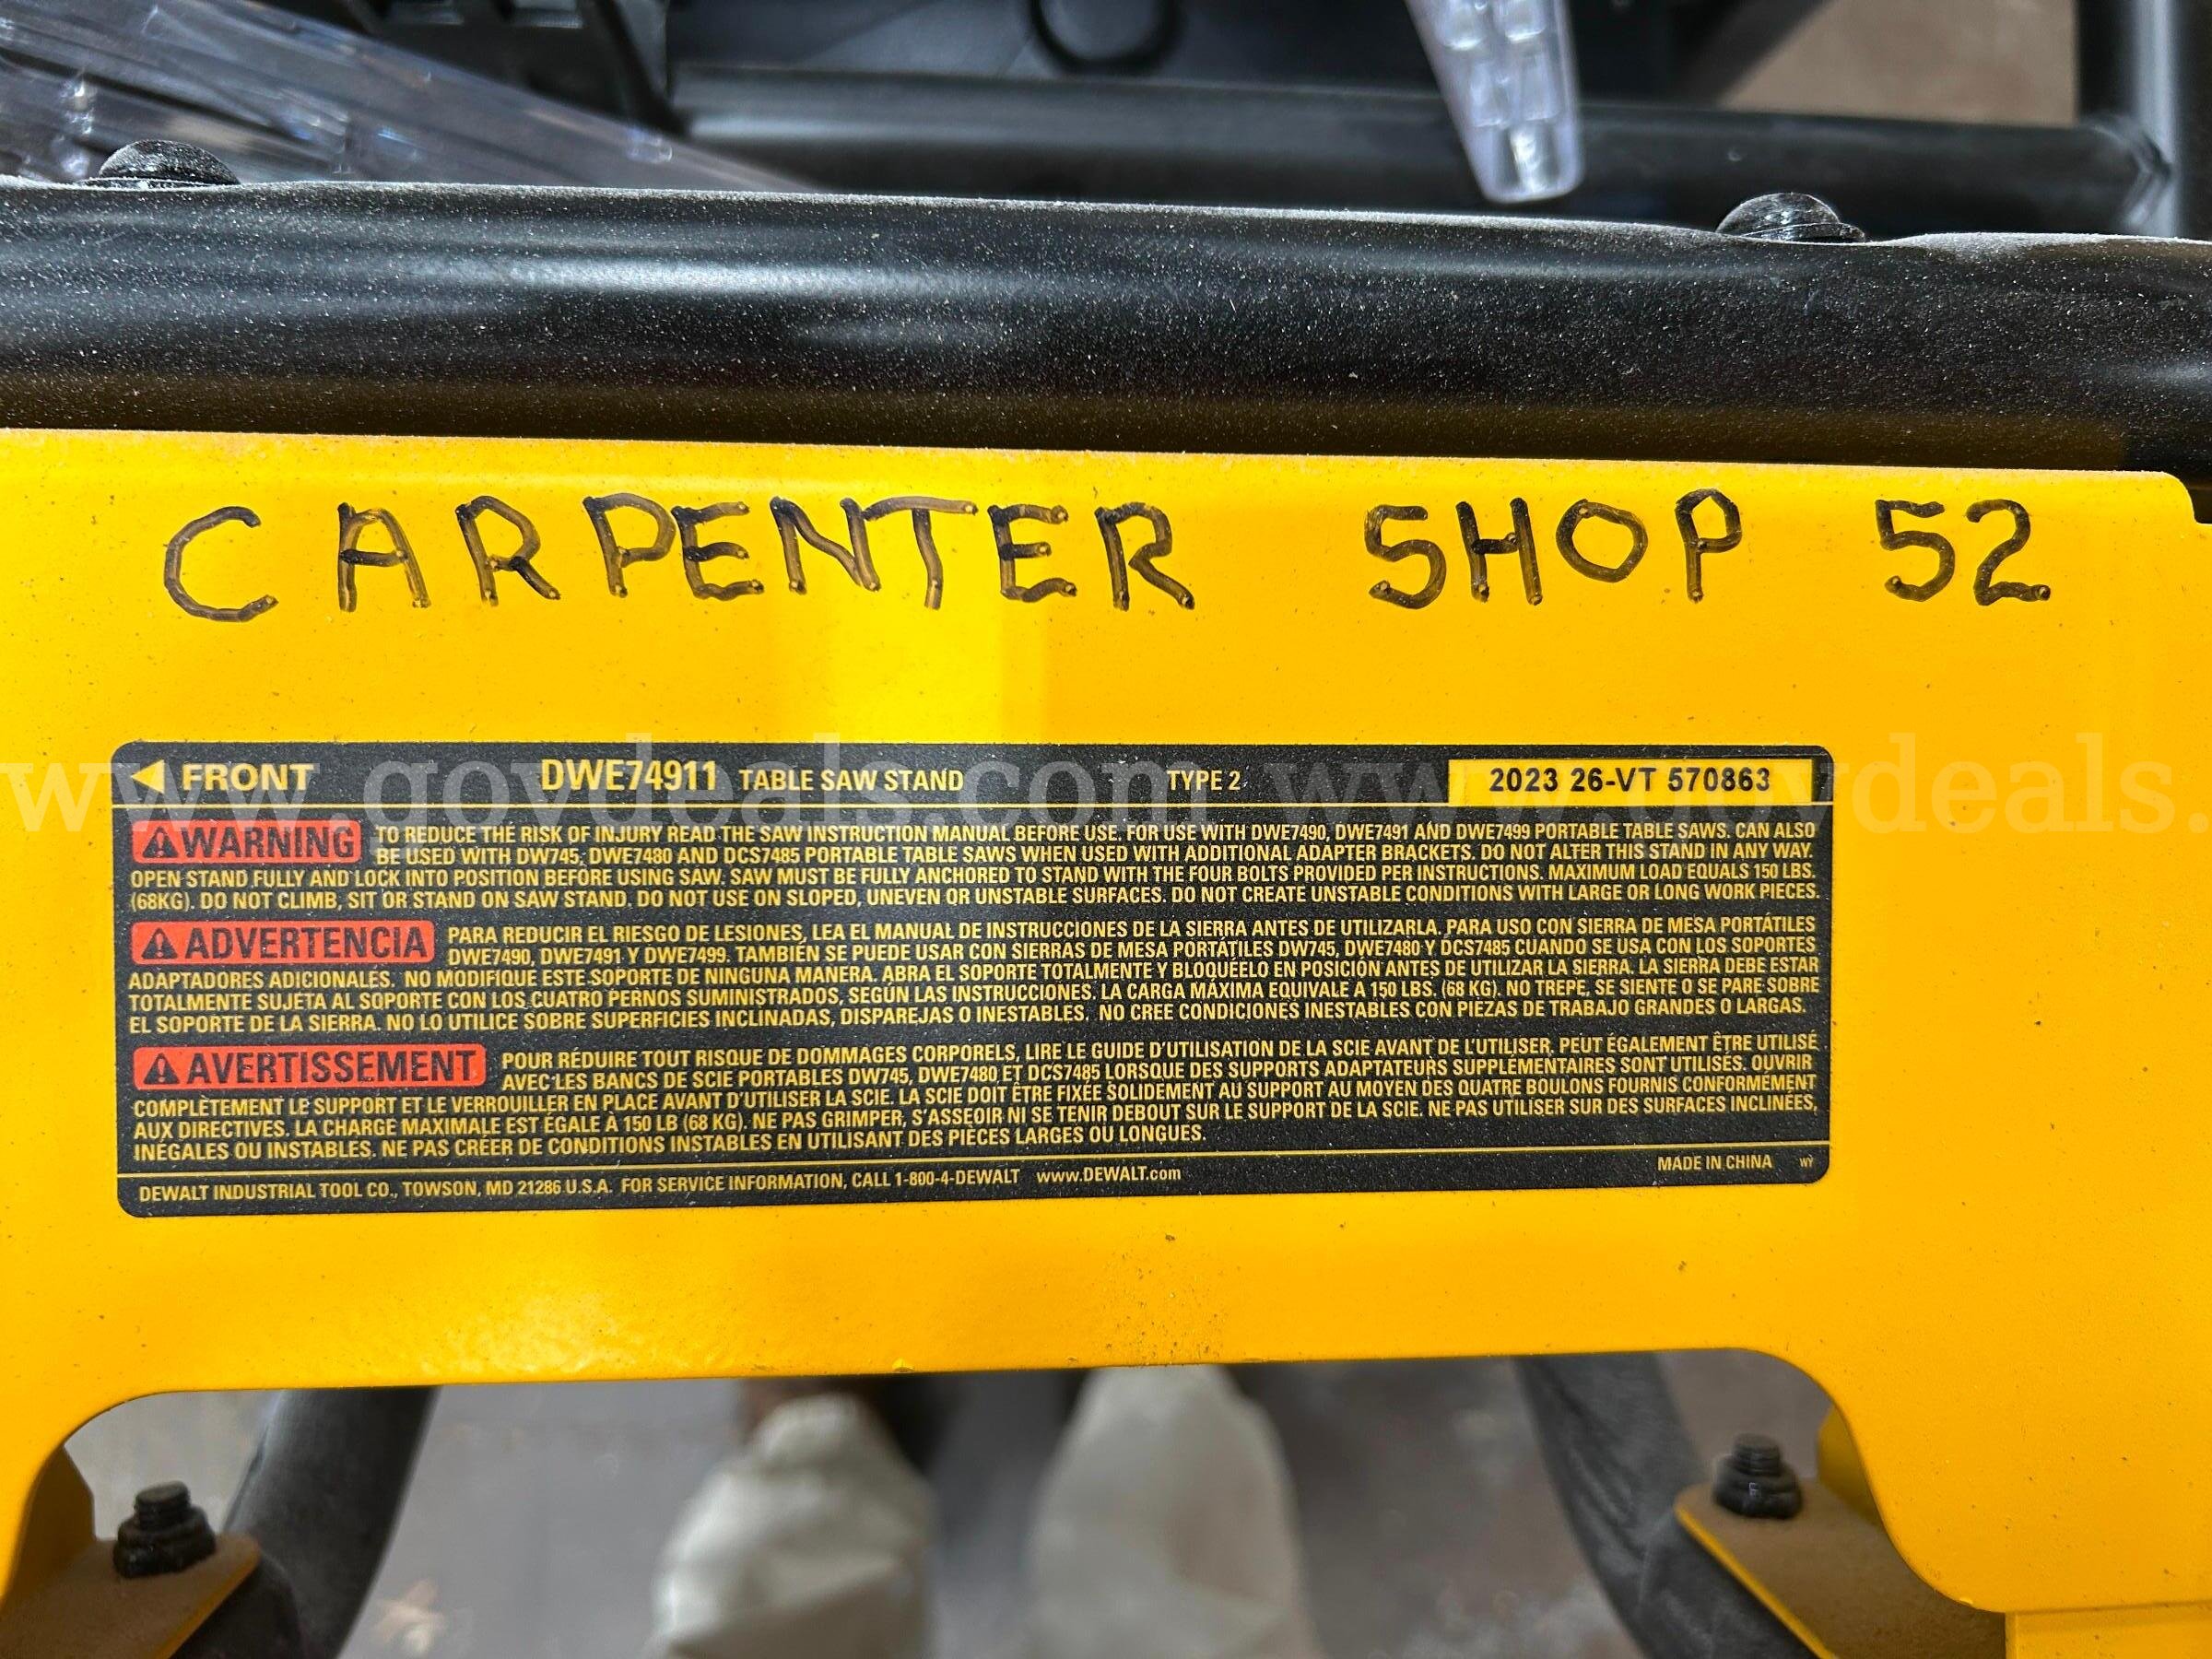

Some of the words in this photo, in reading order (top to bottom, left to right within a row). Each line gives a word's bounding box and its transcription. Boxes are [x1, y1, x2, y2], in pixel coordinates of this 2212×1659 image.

[163, 490, 1197, 623] CARPENTER
[1364, 488, 1743, 610] SHOP
[1875, 498, 2052, 606] 52
[182, 762, 315, 791] FRONT
[540, 759, 717, 791] DWE74911
[739, 769, 814, 791] TABLE
[821, 769, 877, 791] SAW
[884, 768, 964, 791] STAND
[1167, 770, 1222, 791] TYPE
[1229, 770, 1241, 791] 2
[1488, 767, 1559, 792] 2023
[1570, 767, 1657, 792] 26-VT
[1668, 767, 1771, 792] 570863
[181, 827, 355, 858] WARNING
[376, 825, 399, 843] TO
[405, 825, 476, 842] REDUCE
[481, 825, 514, 842] THE
[520, 825, 562, 842] RISK
[568, 825, 589, 842] OF
[594, 825, 662, 842] INJURY
[666, 825, 716, 842] READ
[722, 825, 755, 842] THE
[760, 824, 802, 842] SAW
[807, 824, 928, 841] INSTRUCTION
[933, 824, 1008, 841] MANUAL
[1014, 824, 1078, 841] BEFORE
[1084, 823, 1121, 841] USE.
[1125, 823, 1159, 841] FOR
[1164, 823, 1196, 841] USE
[1202, 823, 1246, 841] WITH
[1252, 823, 1330, 842] DWE7490,
[1335, 822, 1409, 841] DWE7491
[1415, 822, 1452, 840] AND
[1456, 822, 1533, 840] DWE7499
[1535, 822, 1618, 840] PORTABLE
[1624, 821, 1673, 839] TABLE
[1678, 821, 1731, 839] SAWS.
[1735, 821, 1771, 839] CAN
[1773, 821, 1818, 839] ALSO
[199, 891, 227, 910] DO
[232, 891, 271, 909] NOT
[276, 891, 342, 912] CLIMB,
[347, 890, 376, 909] SIT
[382, 890, 407, 908] OR
[413, 890, 477, 908] STAND
[482, 890, 510, 908] ON
[515, 889, 559, 908] SAW
[565, 889, 631, 907] STAND.
[636, 889, 665, 907] DO
[668, 888, 707, 907] NOT
[712, 888, 747, 906] USE
[753, 888, 782, 906] ON
[787, 888, 862, 908] SLOPED,
[866, 888, 941, 905] UNEVEN
[947, 888, 971, 905] OR
[976, 887, 1066, 905] UNSTABLE
[1072, 886, 1166, 904] SURFACES.
[1171, 886, 1196, 903] DO
[1201, 886, 1236, 903] NOT
[1241, 886, 1304, 903] CREATE
[1310, 885, 1400, 903] UNSTABLE
[1406, 884, 1514, 902] CONDITIONS
[1518, 884, 1565, 901] WITH
[1569, 884, 1621, 901] LARGE
[1627, 883, 1653, 901] OR
[1654, 883, 1701, 900] LONG
[1705, 883, 1756, 900] WORK
[1758, 882, 1819, 900] PIECES.
[185, 927, 428, 959] ADVERTENCIA
[448, 925, 498, 944] PARA
[502, 925, 582, 943] REDUCIR
[586, 924, 606, 943] EL
[612, 924, 680, 942] RIESGO
[686, 924, 709, 941] DE
[714, 923, 806, 944] LESIONES,
[811, 923, 845, 940] LEA
[850, 923, 869, 940] EL
[875, 922, 952, 940] MANUAL
[958, 922, 981, 939] DE
[986, 920, 1127, 938] INSTRUCCIONES
[1133, 920, 1153, 937] DE
[1159, 920, 1181, 937] LA
[1186, 919, 1247, 937] SIERRA
[1253, 919, 1309, 936] ANTES
[1314, 918, 1335, 935] DE
[1340, 917, 1441, 935] UTILIZARLA.
[1446, 917, 1493, 935] PARA
[1497, 917, 1533, 935] USO
[1537, 916, 1574, 935] CON
[1577, 916, 1639, 934] SIERRA
[1641, 916, 1663, 934] DE
[1667, 915, 1718, 934] MESA
[1720, 912, 1816, 933] PORTÁTILES
[502, 1051, 553, 1069] POUR
[558, 1046, 636, 1068] RÉDUIRE
[641, 1049, 689, 1066] TOUT
[695, 1047, 761, 1066] RISQUE
[767, 1047, 791, 1065] DE
[796, 1045, 907, 1065] DOMMAGES
[912, 1043, 1019, 1065] CORPORELS,
[1024, 1042, 1061, 1061] LIRE
[1066, 1042, 1086, 1060] LE
[1091, 1041, 1143, 1060] GUIDE
[1148, 1040, 1275, 1059] D'UTILISATION
[1279, 1040, 1300, 1057] DE
[1306, 1039, 1328, 1056] LA
[1333, 1039, 1370, 1056] SCIE
[1375, 1038, 1432, 1055] AVANT
[1438, 1037, 1459, 1055] DE
[1559, 1035, 1602, 1053] PEUT
[1606, 1030, 1709, 1053] ÉGALEMENT
[1712, 1030, 1753, 1052] ÊTRE
[1757, 1030, 1818, 1051] UTILISÉ
[187, 1050, 477, 1085] AVERTISSEMENT
[135, 1138, 229, 1161] INÉGALES
[234, 1142, 262, 1159] OU
[266, 1140, 375, 1159] INSTABLES.
[380, 1140, 406, 1158] NE
[411, 1139, 449, 1157] PAS
[454, 1135, 514, 1157] CRÉER
[517, 1137, 542, 1156] DE
[547, 1135, 665, 1155] CONDITIONS
[669, 1133, 772, 1153] INSTABLES
[776, 1133, 802, 1150] EN
[807, 1131, 902, 1150] UTILISANT
[908, 1130, 943, 1147] DES
[947, 1124, 1010, 1147] PIÈCES
[1016, 1126, 1084, 1146] LARGES
[1089, 1125, 1114, 1144] OU
[1119, 1124, 1206, 1143] LONGUES.
[1657, 1155, 1701, 1171] MADE
[1706, 1155, 1722, 1171] IN
[1726, 1154, 1772, 1170] CHINA
[140, 1183, 208, 1202] DEWALT
[214, 1182, 314, 1201] INDUSTRIAL
[320, 1182, 360, 1199] TOOL
[366, 1181, 397, 1201] CO.,
[401, 1180, 479, 1201] TOWSON,
[484, 1179, 513, 1196] MD
[518, 1178, 562, 1196] 21286
[564, 1177, 614, 1195] U.S.A.
[619, 1176, 653, 1194] FOR
[657, 1174, 723, 1194] SERVICE
[728, 1171, 846, 1194] INFORMATION,
[851, 1171, 889, 1189] CALL
[895, 1168, 1020, 1188] 1-800-4-DEWALT
[1036, 1163, 1182, 1184] www.DEWALT.com
